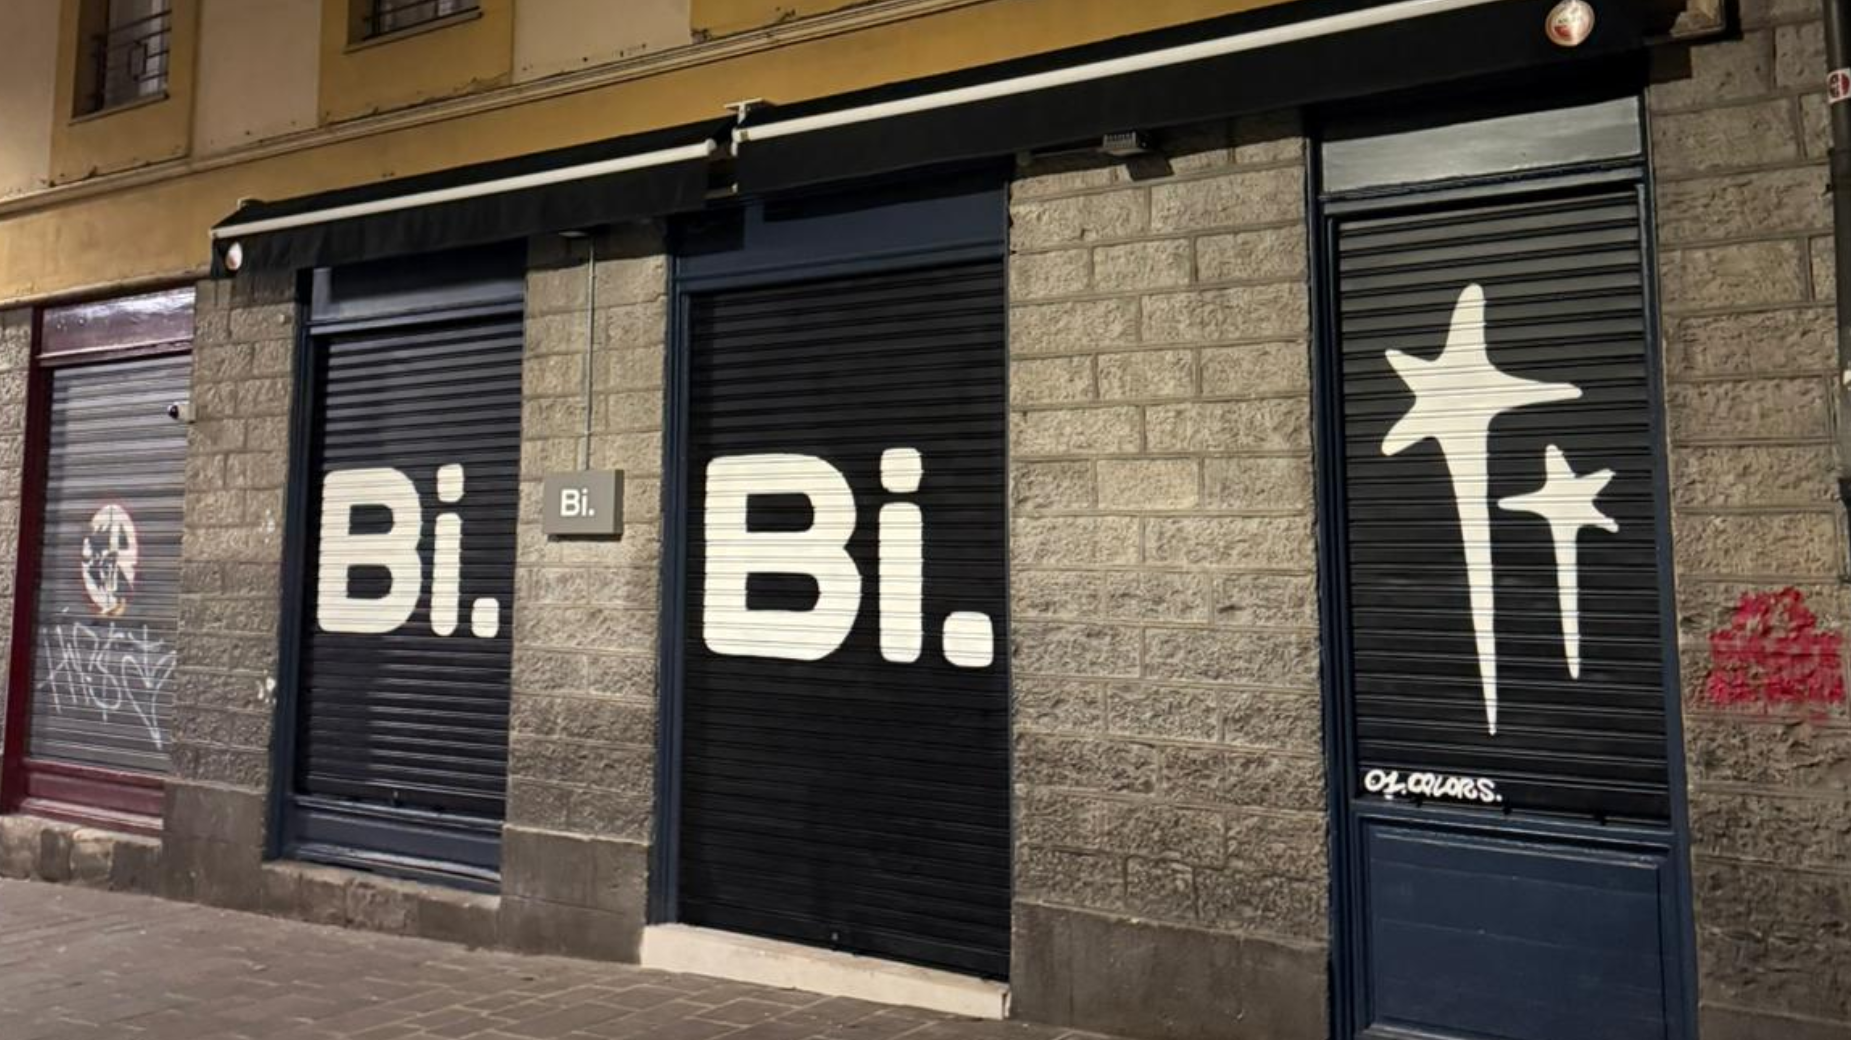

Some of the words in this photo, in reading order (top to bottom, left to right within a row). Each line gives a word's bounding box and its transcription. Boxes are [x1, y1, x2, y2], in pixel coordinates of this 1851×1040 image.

[317, 463, 499, 638] Bi.
[561, 488, 595, 517] Bi.
[703, 447, 994, 668] Bi.
